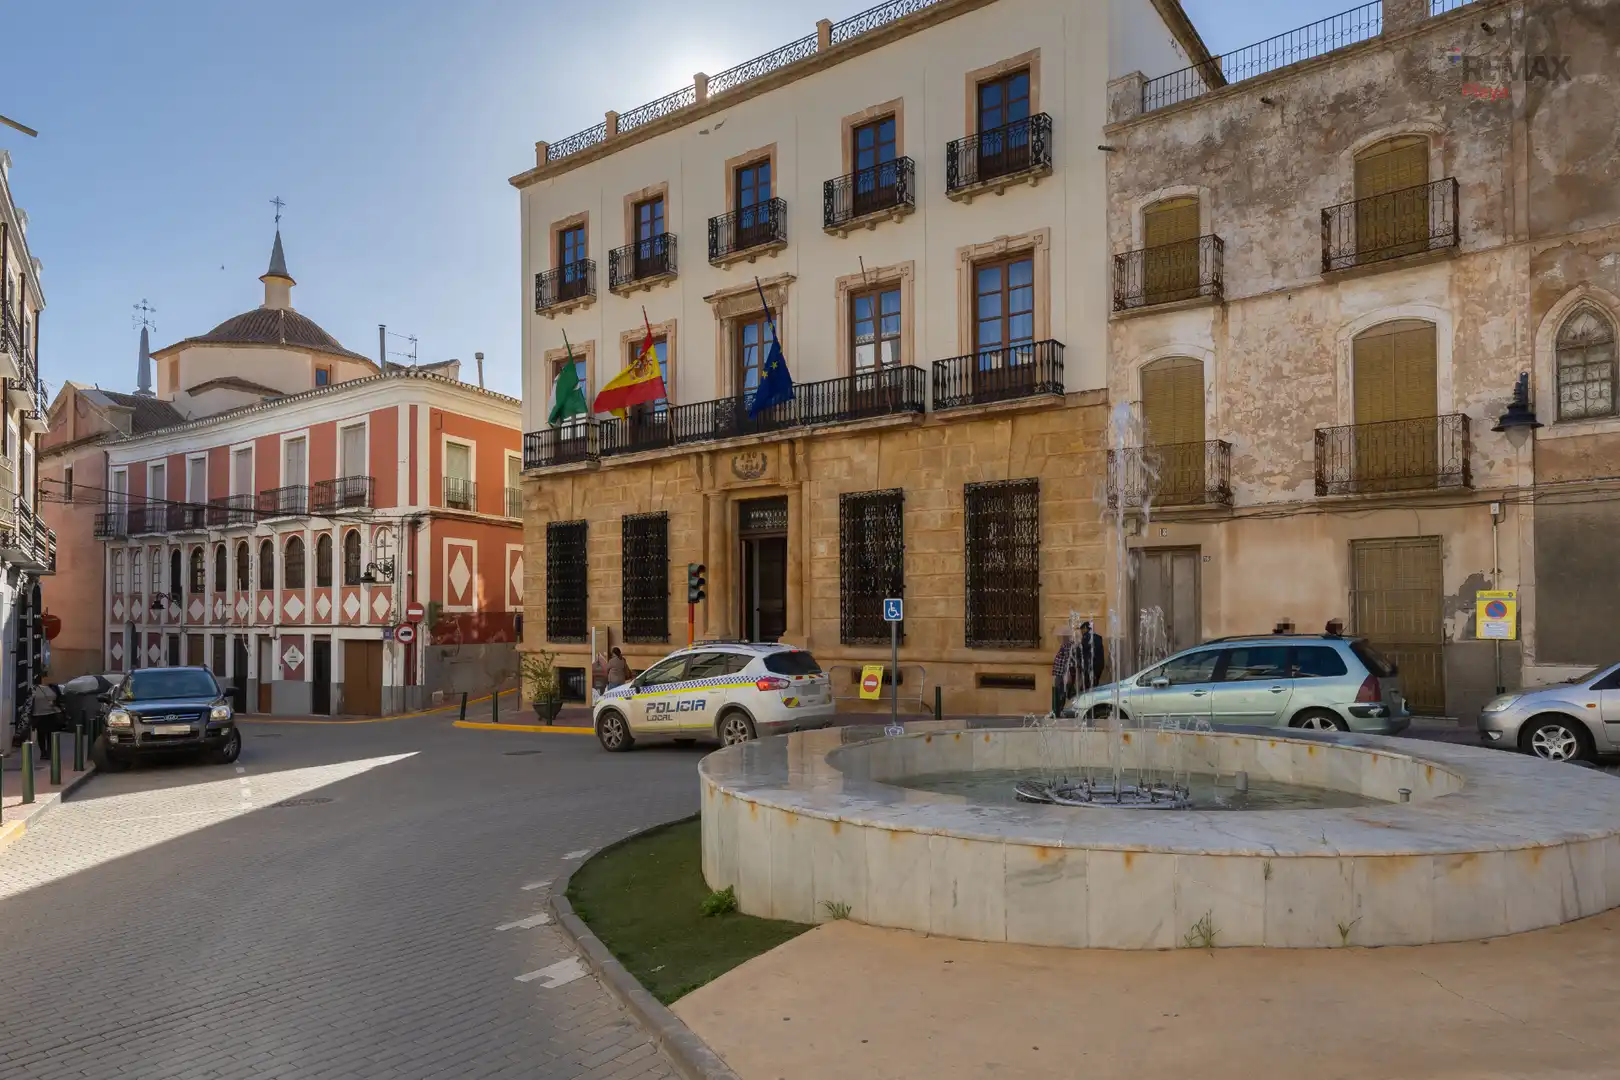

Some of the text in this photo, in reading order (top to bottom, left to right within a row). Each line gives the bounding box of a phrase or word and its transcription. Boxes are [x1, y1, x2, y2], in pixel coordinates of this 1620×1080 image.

[1159, 528, 1167, 537] 18
[646, 699, 706, 713] POLICIA
[646, 714, 673, 722] LOCAL
